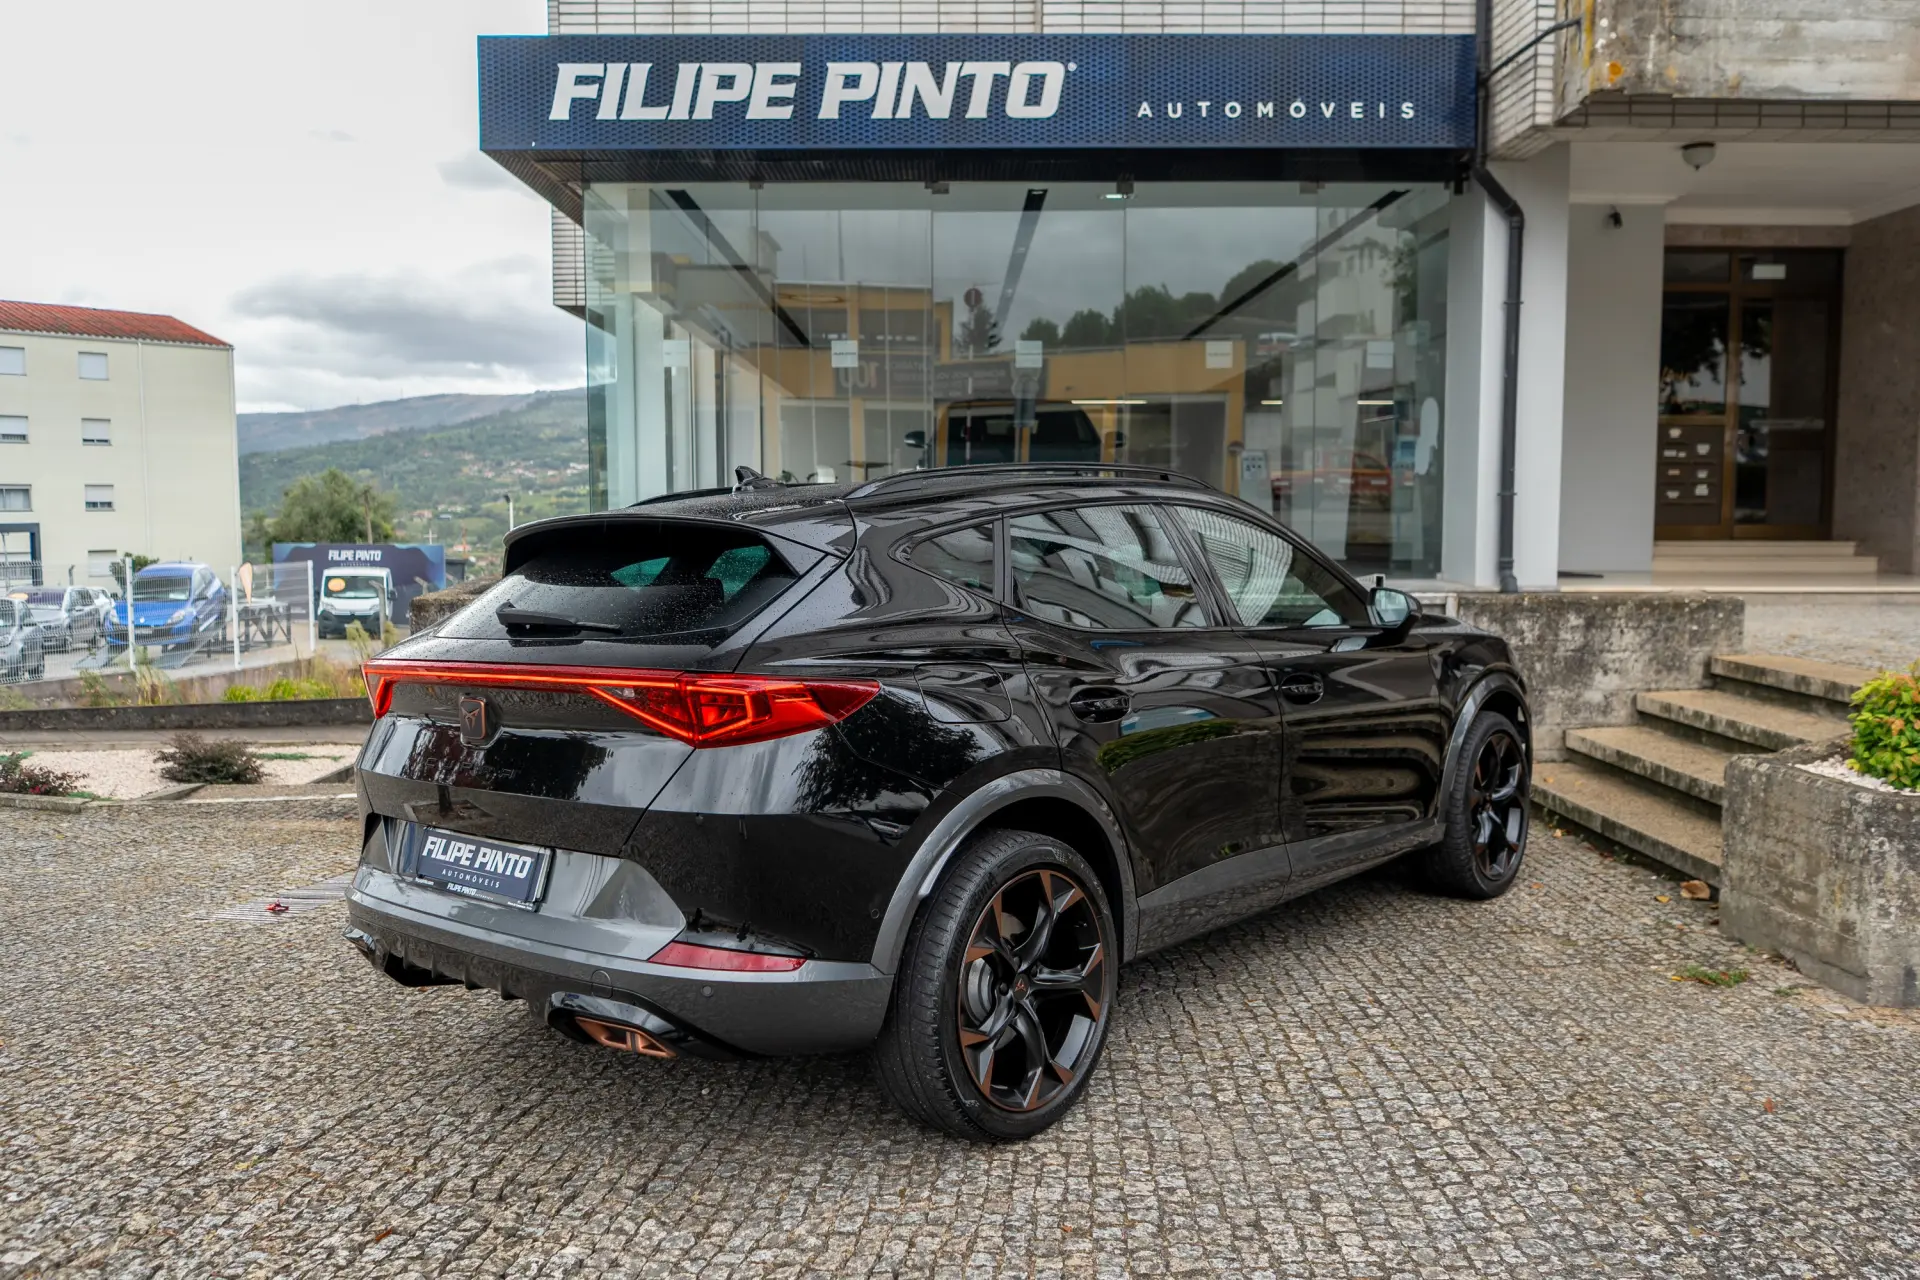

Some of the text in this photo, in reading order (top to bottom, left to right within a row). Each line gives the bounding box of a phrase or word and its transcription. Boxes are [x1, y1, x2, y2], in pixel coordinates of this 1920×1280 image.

[549, 61, 1066, 121] FILIPE PINTO
[1136, 98, 1416, 119] AUTOMÓVEIS
[328, 549, 382, 561] FILIPE PINTO
[421, 835, 533, 879] FILIPE PINTO
[441, 868, 500, 888] AUTOMÓVEIS
